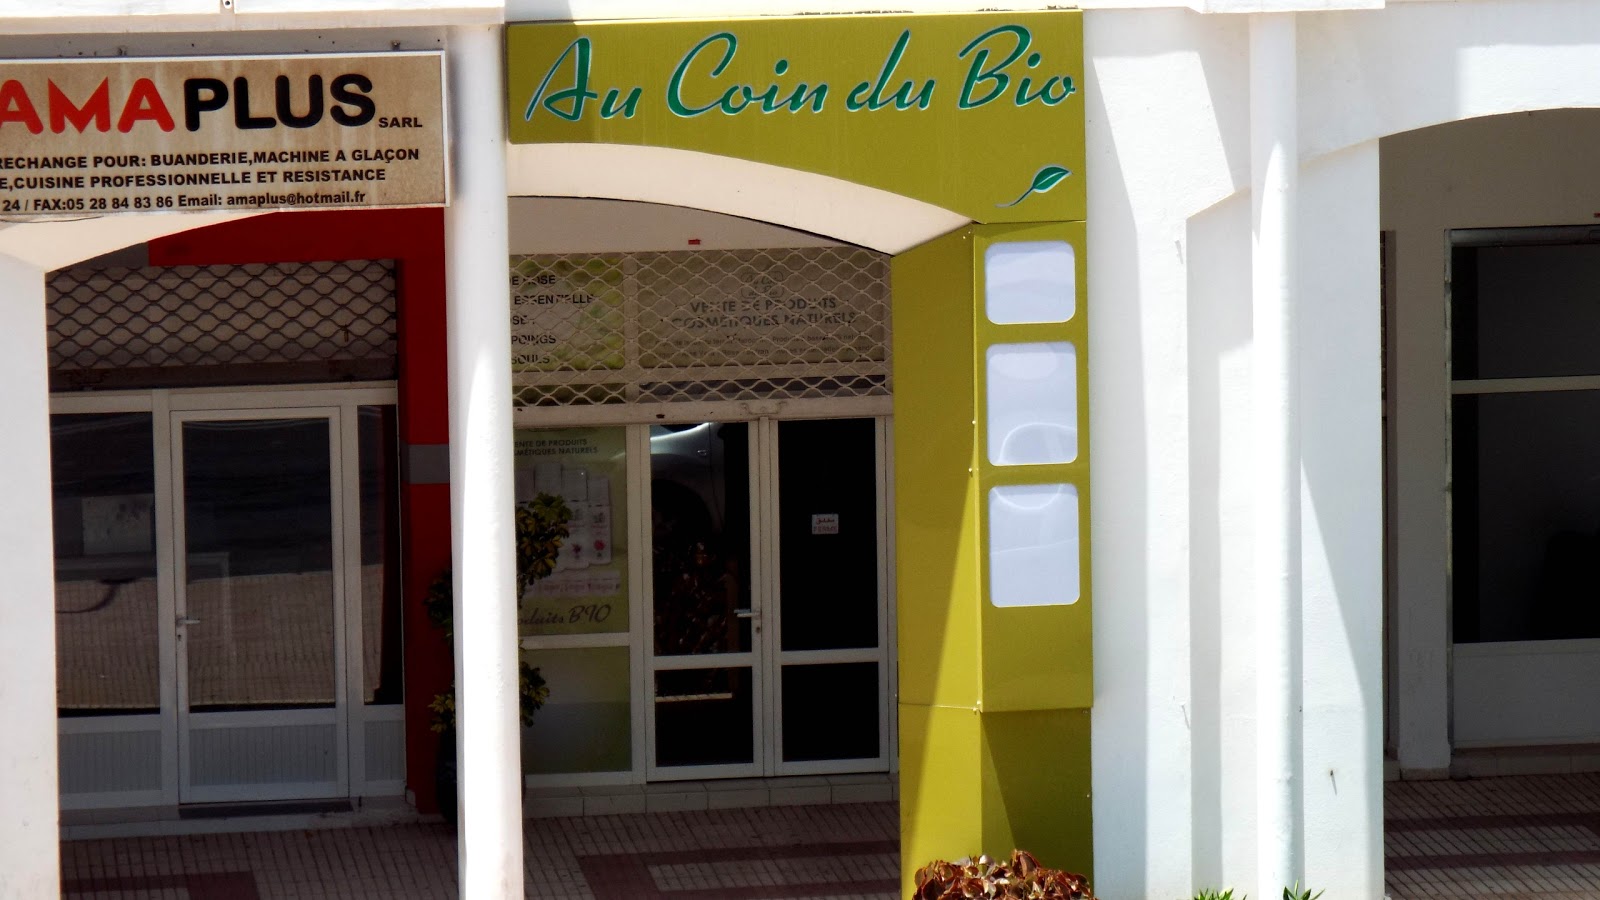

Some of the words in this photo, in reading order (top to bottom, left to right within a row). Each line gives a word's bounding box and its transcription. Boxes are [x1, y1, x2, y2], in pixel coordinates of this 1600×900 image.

[524, 37, 641, 122] Au
[666, 31, 828, 119] Coin
[847, 29, 935, 112] du
[958, 24, 1076, 110] Bio
[378, 116, 423, 128] SARL
[93, 155, 146, 168] POUR:
[336, 149, 347, 162] A
[352, 148, 420, 164] GLAÇON
[90, 172, 251, 188] PROFESSIONNELLE
[257, 171, 278, 183] ET
[283, 168, 386, 182] RESISTANCE
[3, 199, 21, 212] 24
[89, 198, 107, 210] 28
[112, 197, 129, 209] 84
[134, 196, 151, 208] 83
[156, 196, 173, 208] 86
[178, 194, 222, 207] Email:
[226, 191, 366, 207] amaplus@hotmail.fr
[548, 438, 588, 447] PRODUITS
[558, 446, 599, 455] NATURELS
